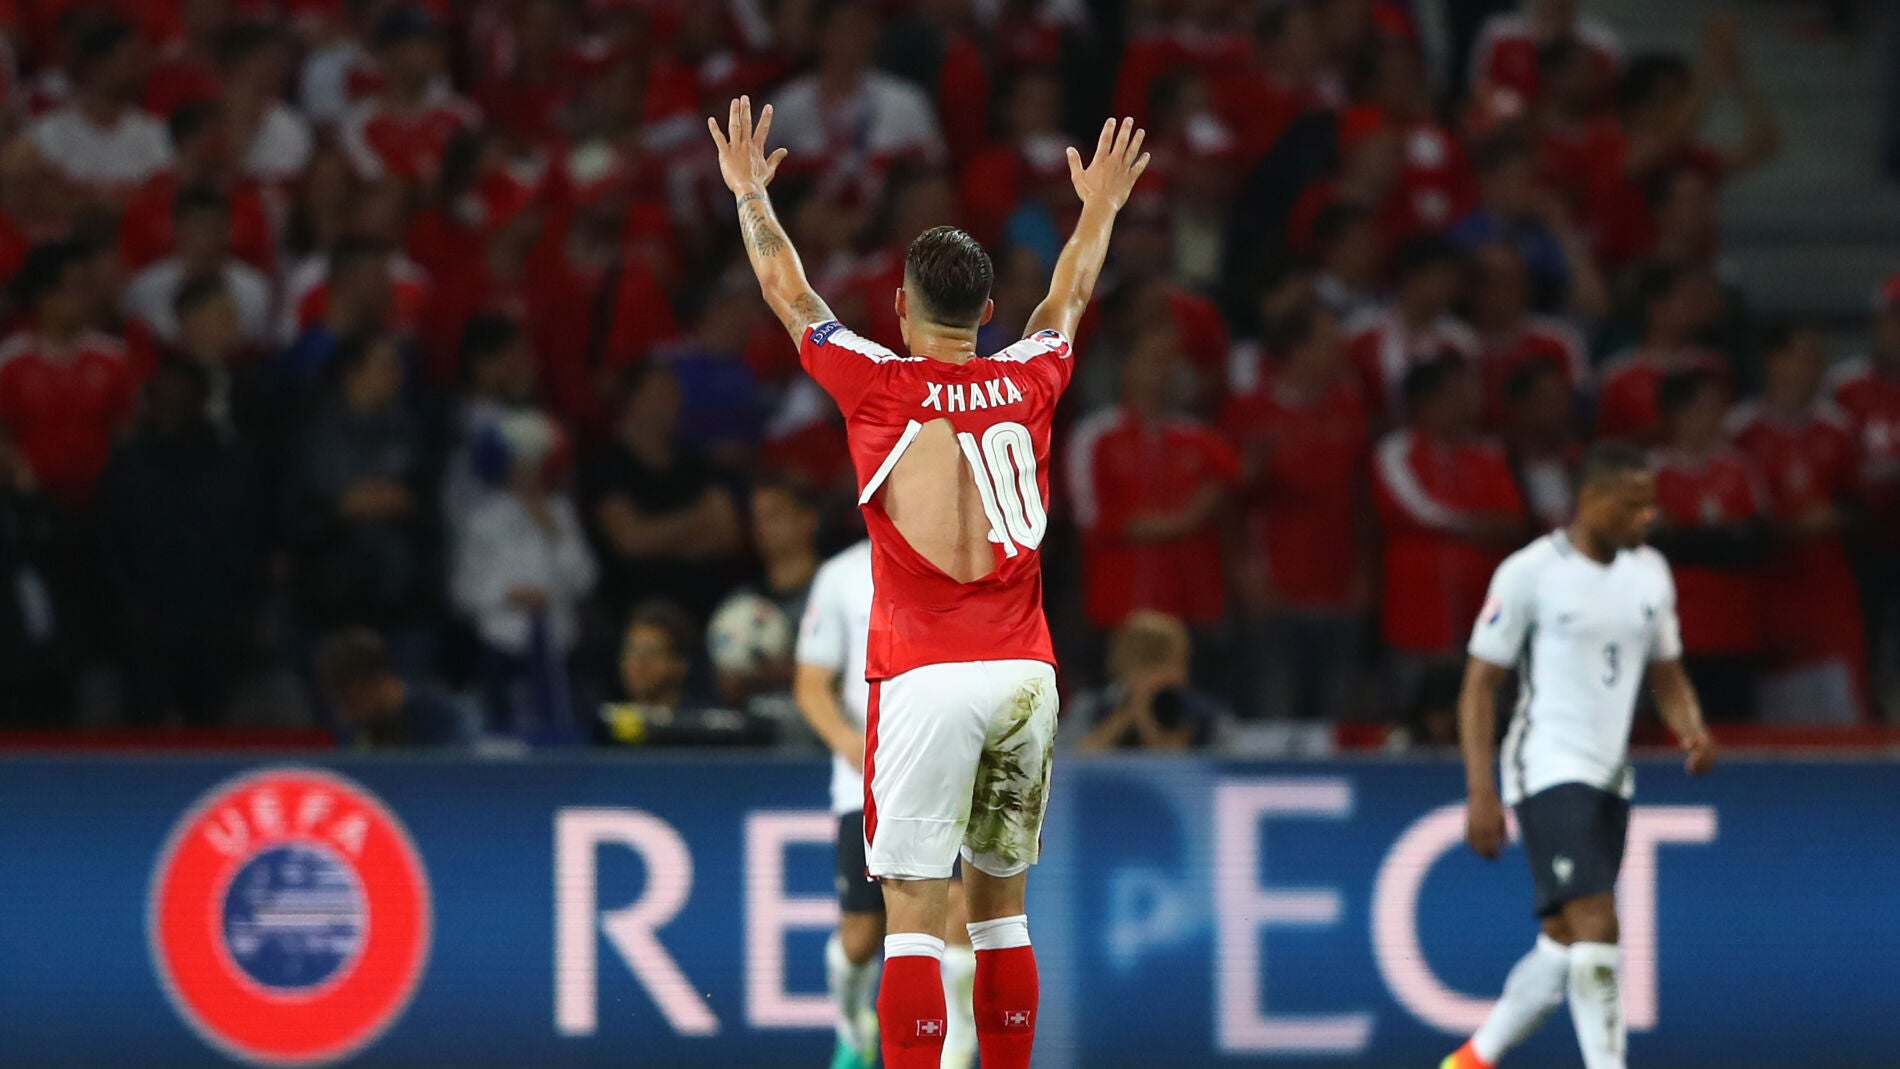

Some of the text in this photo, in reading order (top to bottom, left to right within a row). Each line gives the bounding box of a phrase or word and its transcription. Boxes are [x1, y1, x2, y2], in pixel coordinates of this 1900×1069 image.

[921, 376, 1023, 412] XHAKA
[957, 421, 1047, 558] 10
[1602, 641, 1622, 688] 3
[203, 788, 369, 857] UEFA
